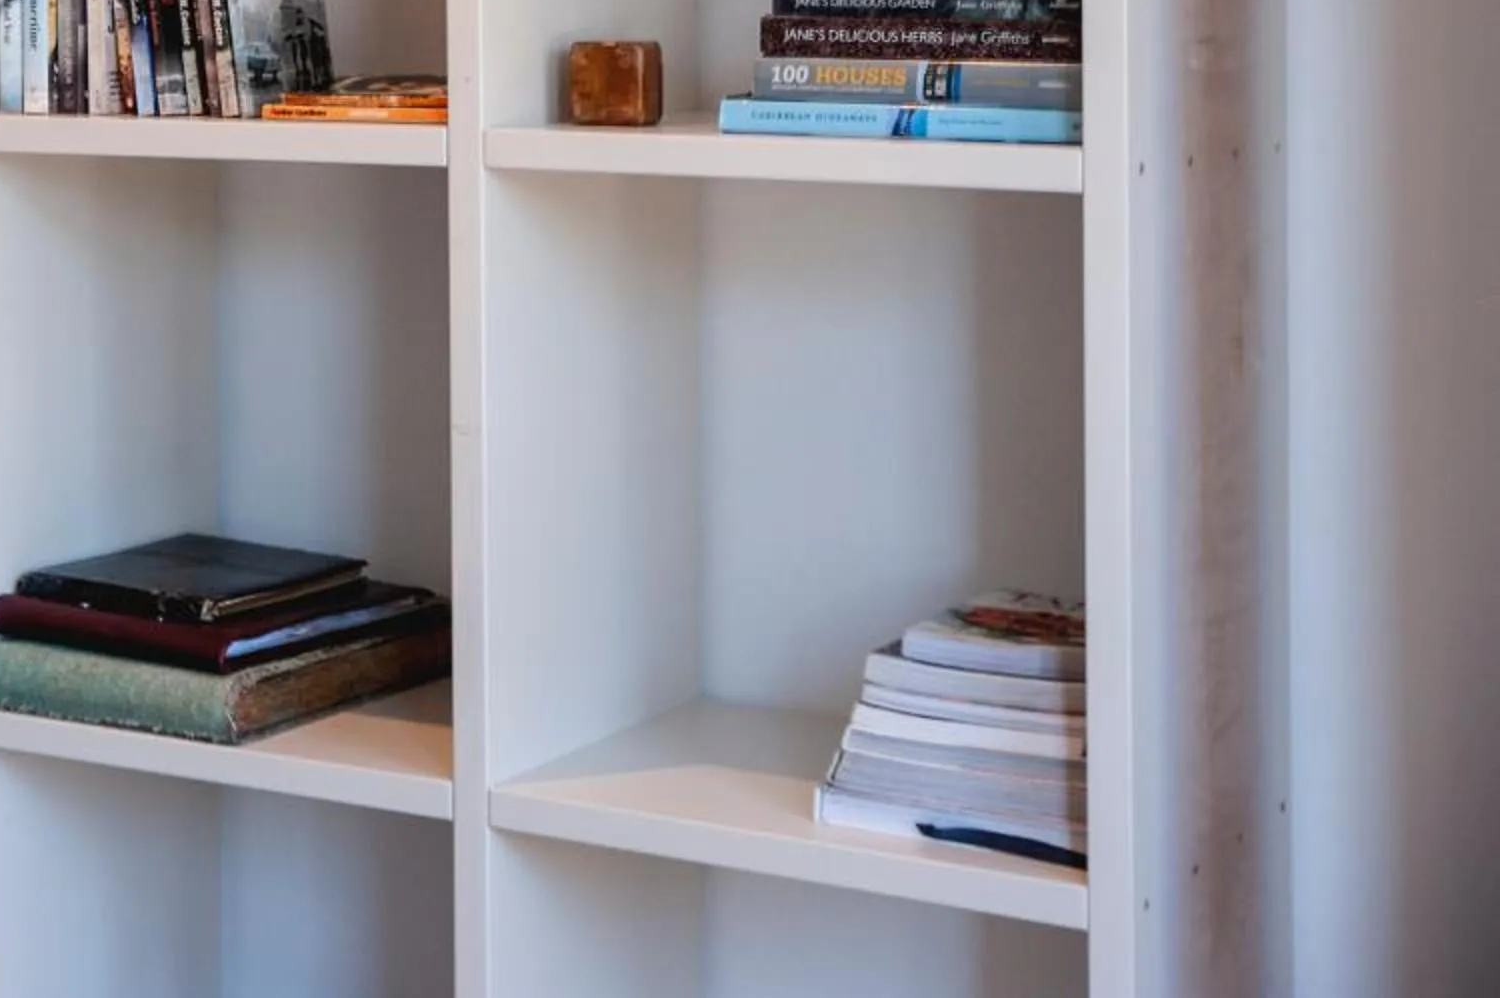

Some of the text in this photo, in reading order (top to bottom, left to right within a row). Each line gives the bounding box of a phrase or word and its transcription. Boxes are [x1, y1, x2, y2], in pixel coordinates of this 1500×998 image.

[784, 27, 1030, 47] JANE'S DELICIOUS HERBS Jane Griffiths
[771, 64, 907, 86] 100 HOUSES
